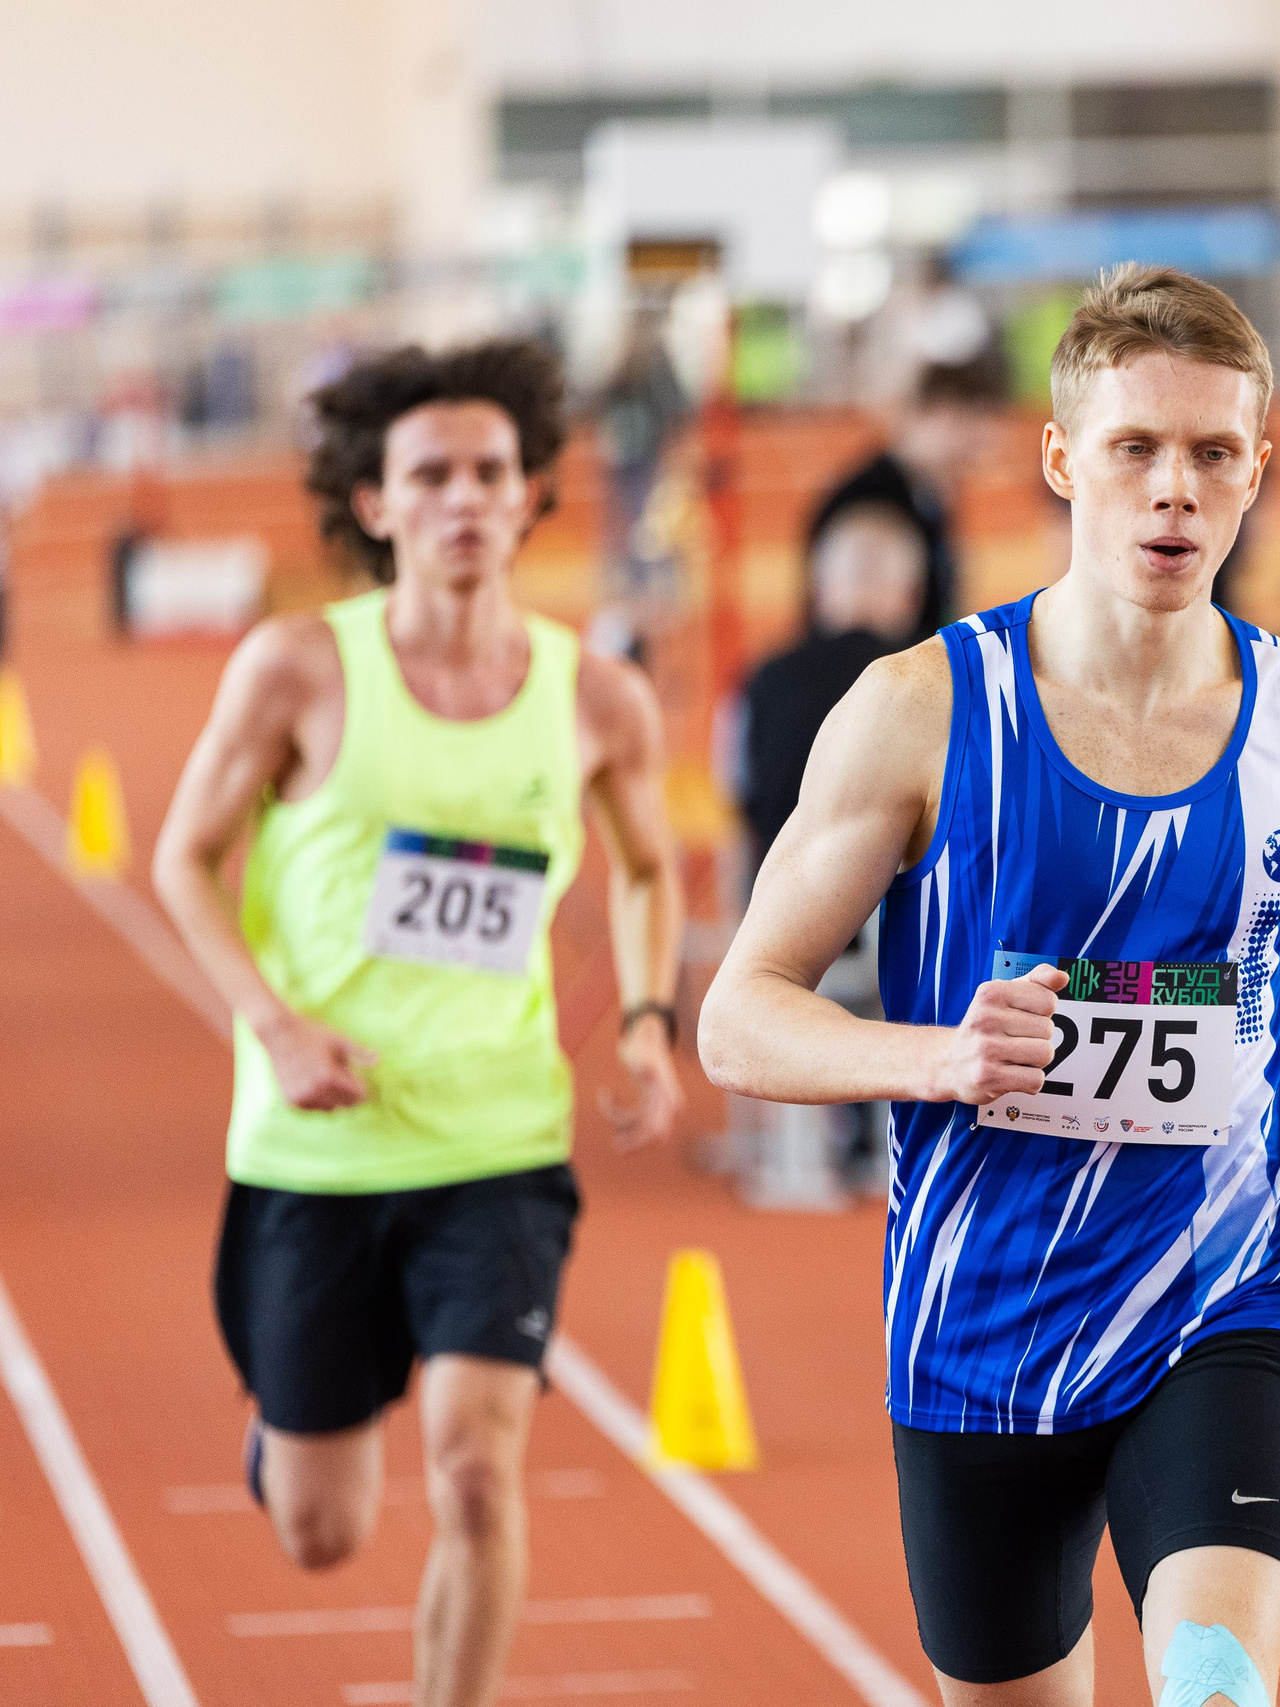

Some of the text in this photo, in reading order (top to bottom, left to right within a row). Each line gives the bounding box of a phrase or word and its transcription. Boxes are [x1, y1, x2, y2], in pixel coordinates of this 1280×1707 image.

[396, 870, 515, 944] 205
[1150, 987, 1220, 1006] КУБОК
[1152, 968, 1221, 987] СТУД
[1040, 1013, 1198, 1103] 275
